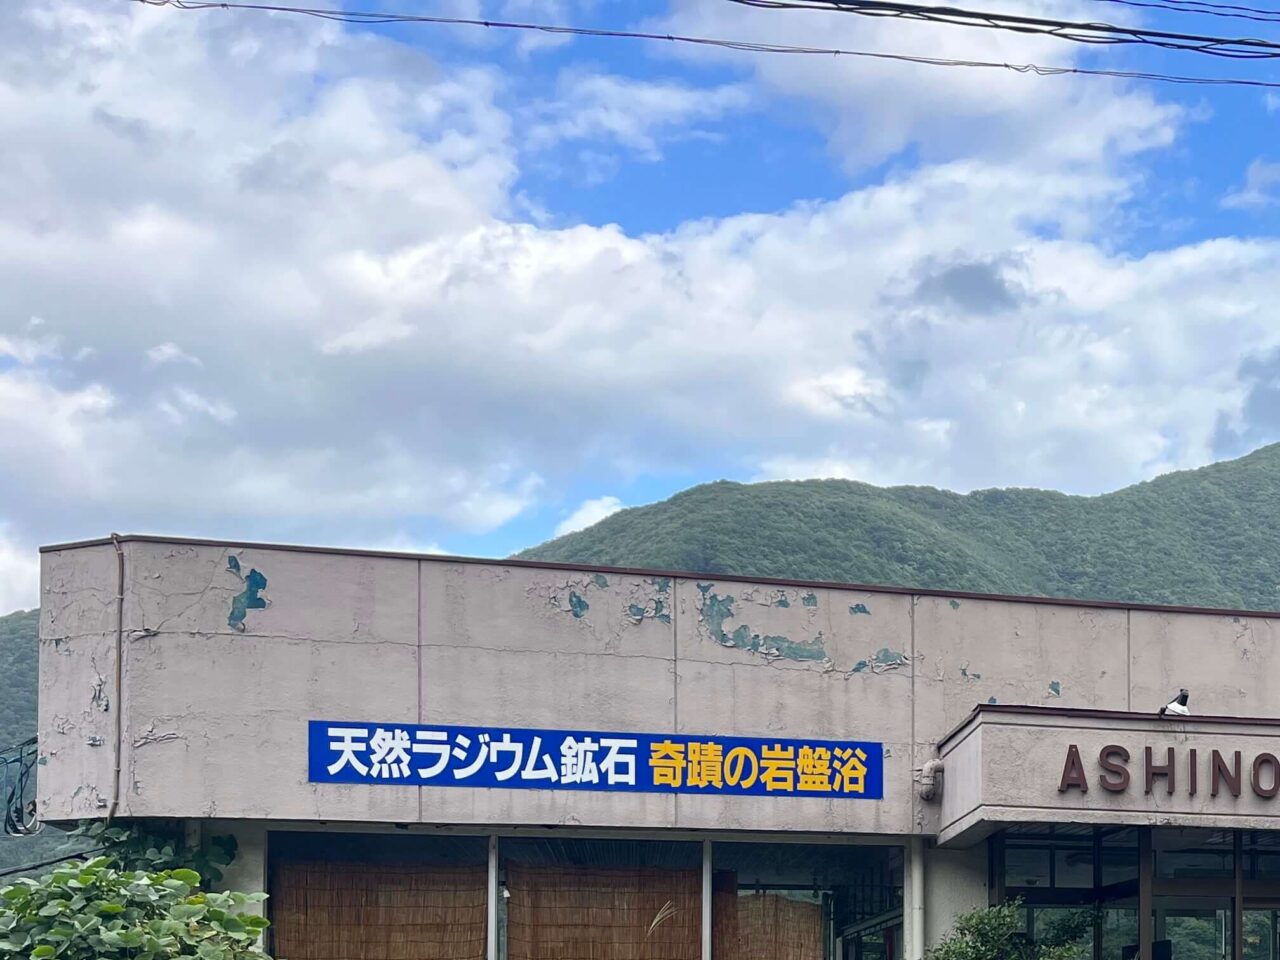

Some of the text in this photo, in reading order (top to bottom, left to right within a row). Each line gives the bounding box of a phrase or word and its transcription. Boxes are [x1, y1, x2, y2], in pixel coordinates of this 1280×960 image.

[326, 726, 868, 794] 天然ラジウム鉱石 奇蹟の岩盤浴
